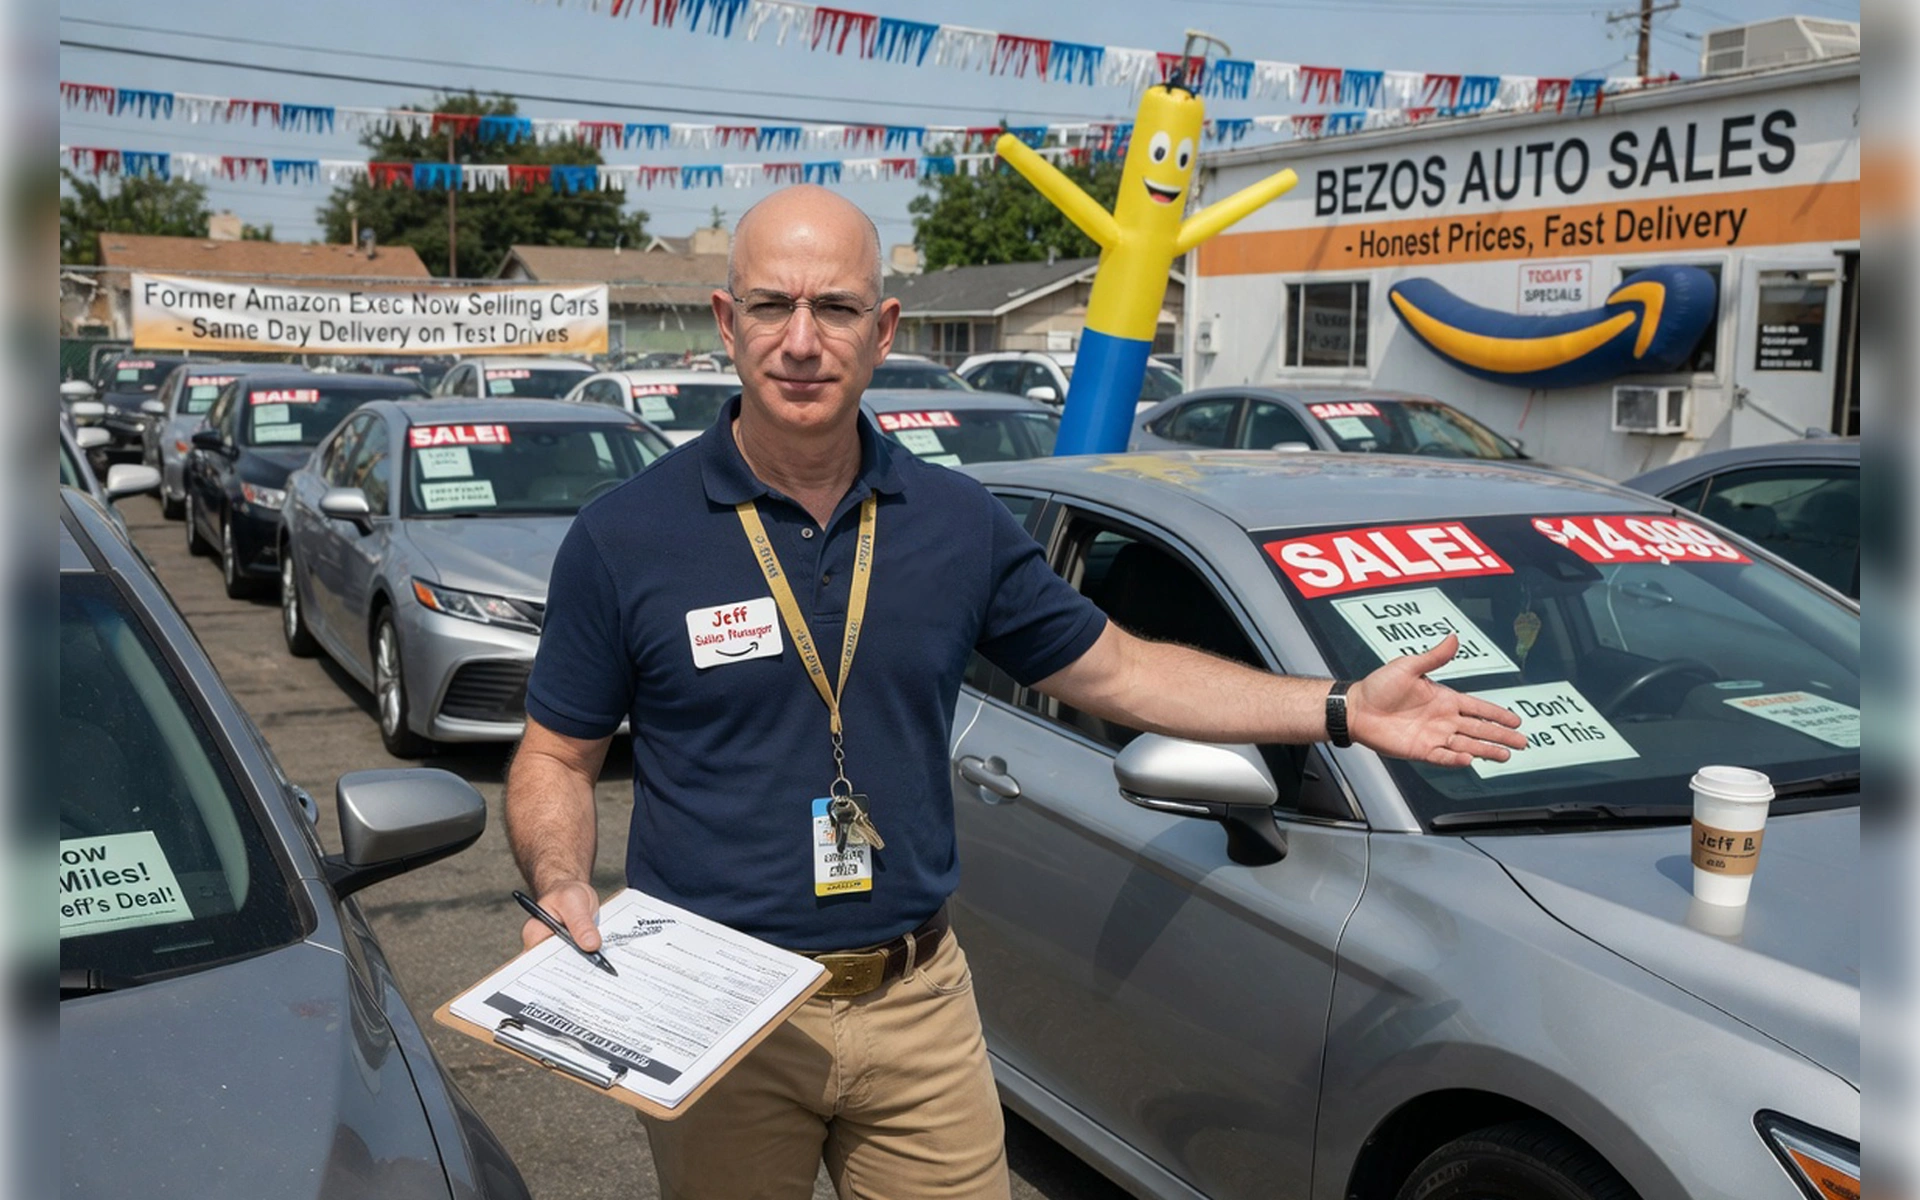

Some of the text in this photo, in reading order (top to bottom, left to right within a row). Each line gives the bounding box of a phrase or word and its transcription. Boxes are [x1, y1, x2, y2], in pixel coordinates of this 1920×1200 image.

[1315, 108, 1797, 217] BEZOS AUTO SALES
[1360, 225, 1441, 259] Honest
[1448, 221, 1534, 257] Prices,
[1544, 211, 1605, 248] Fast
[1615, 205, 1748, 246] Delivery
[144, 282, 599, 321] Former Amazon Exec Now Selling Cars
[192, 316, 259, 340] Same
[268, 318, 311, 348] Day
[319, 319, 411, 348] Delivery
[418, 327, 445, 343] on
[452, 321, 496, 343] Test
[503, 322, 569, 346] Drives
[411, 425, 507, 447] SALE!
[1281, 525, 1501, 588] SALE!
[712, 606, 748, 627] Jeff
[1362, 601, 1421, 619] Low
[1515, 695, 1584, 718] Don't
[1551, 721, 1606, 743] This
[60, 845, 106, 867] ow
[60, 861, 151, 893] Miles!
[60, 886, 176, 918] eff's Deal!
